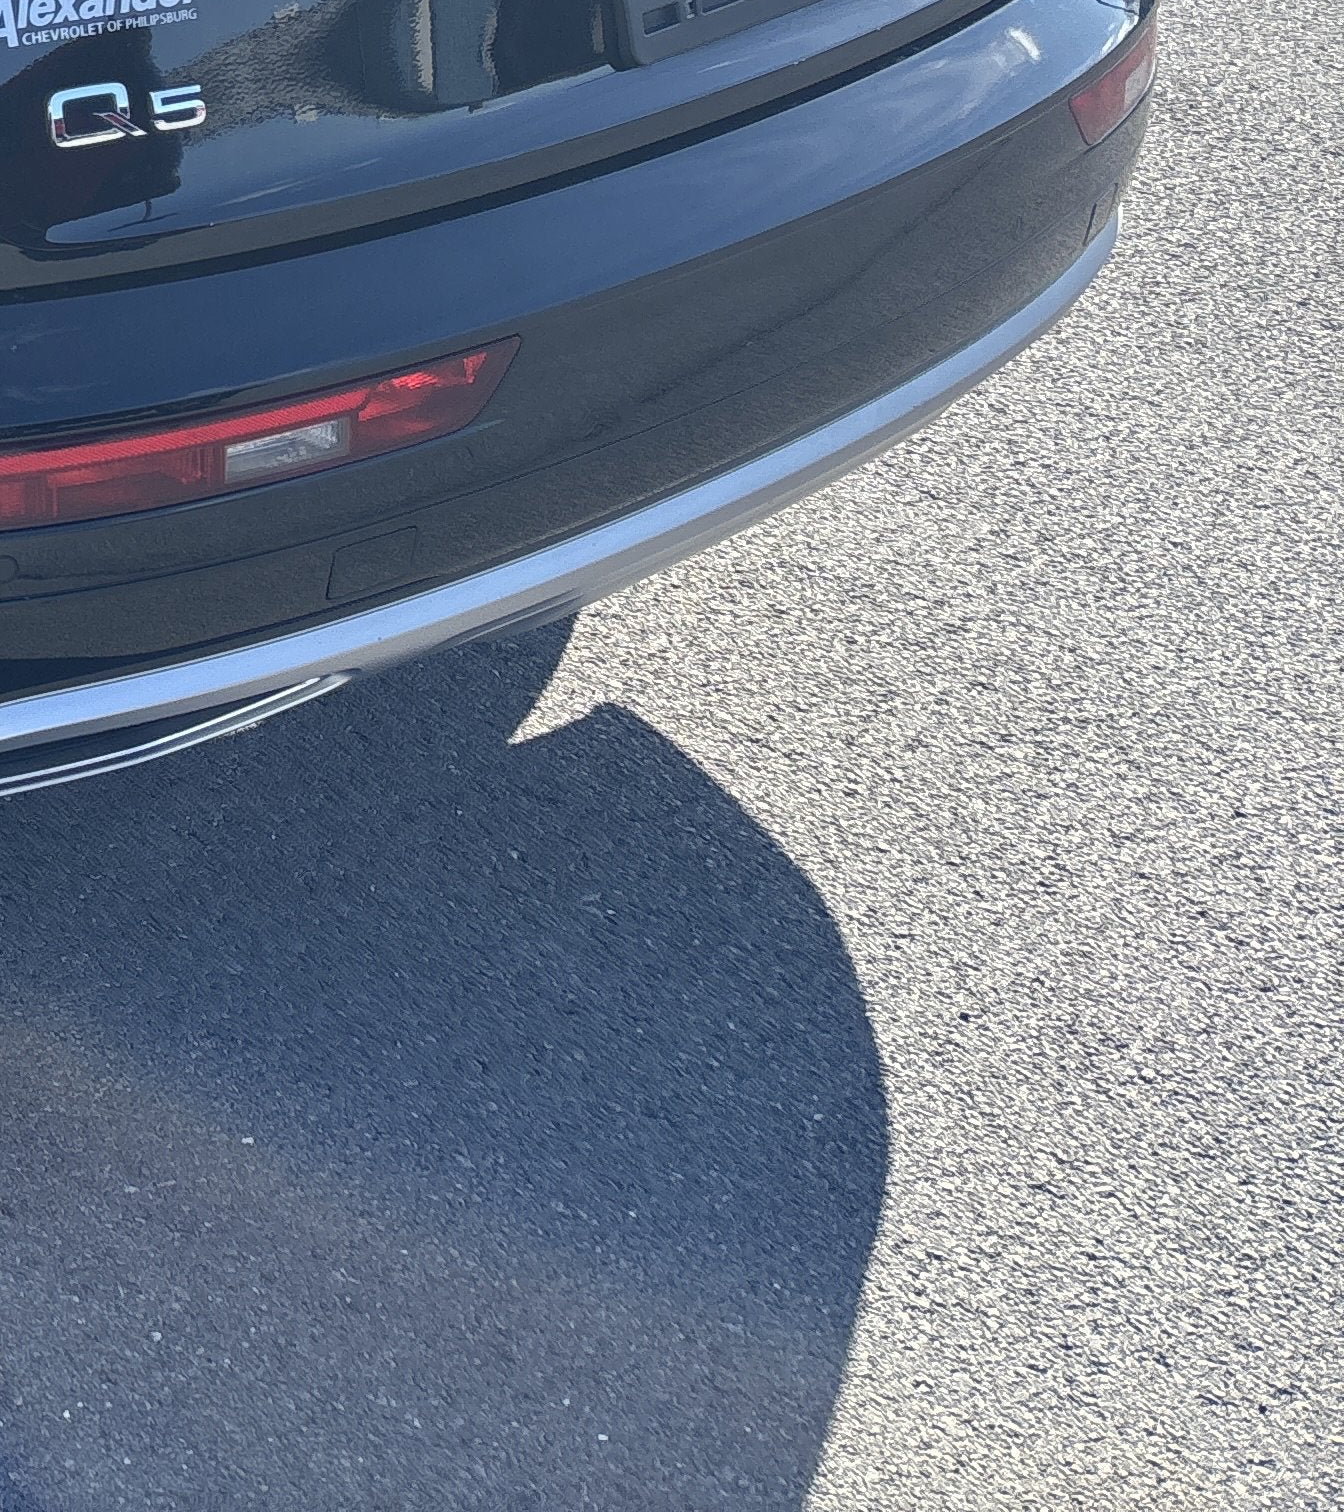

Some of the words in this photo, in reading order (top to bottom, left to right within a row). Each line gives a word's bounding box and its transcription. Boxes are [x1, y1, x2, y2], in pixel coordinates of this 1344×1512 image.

[21, 21, 105, 46] CHEVROLET
[107, 19, 124, 32] OF
[124, 8, 198, 31] PHILIPSBURG
[48, 82, 207, 148] Q5
